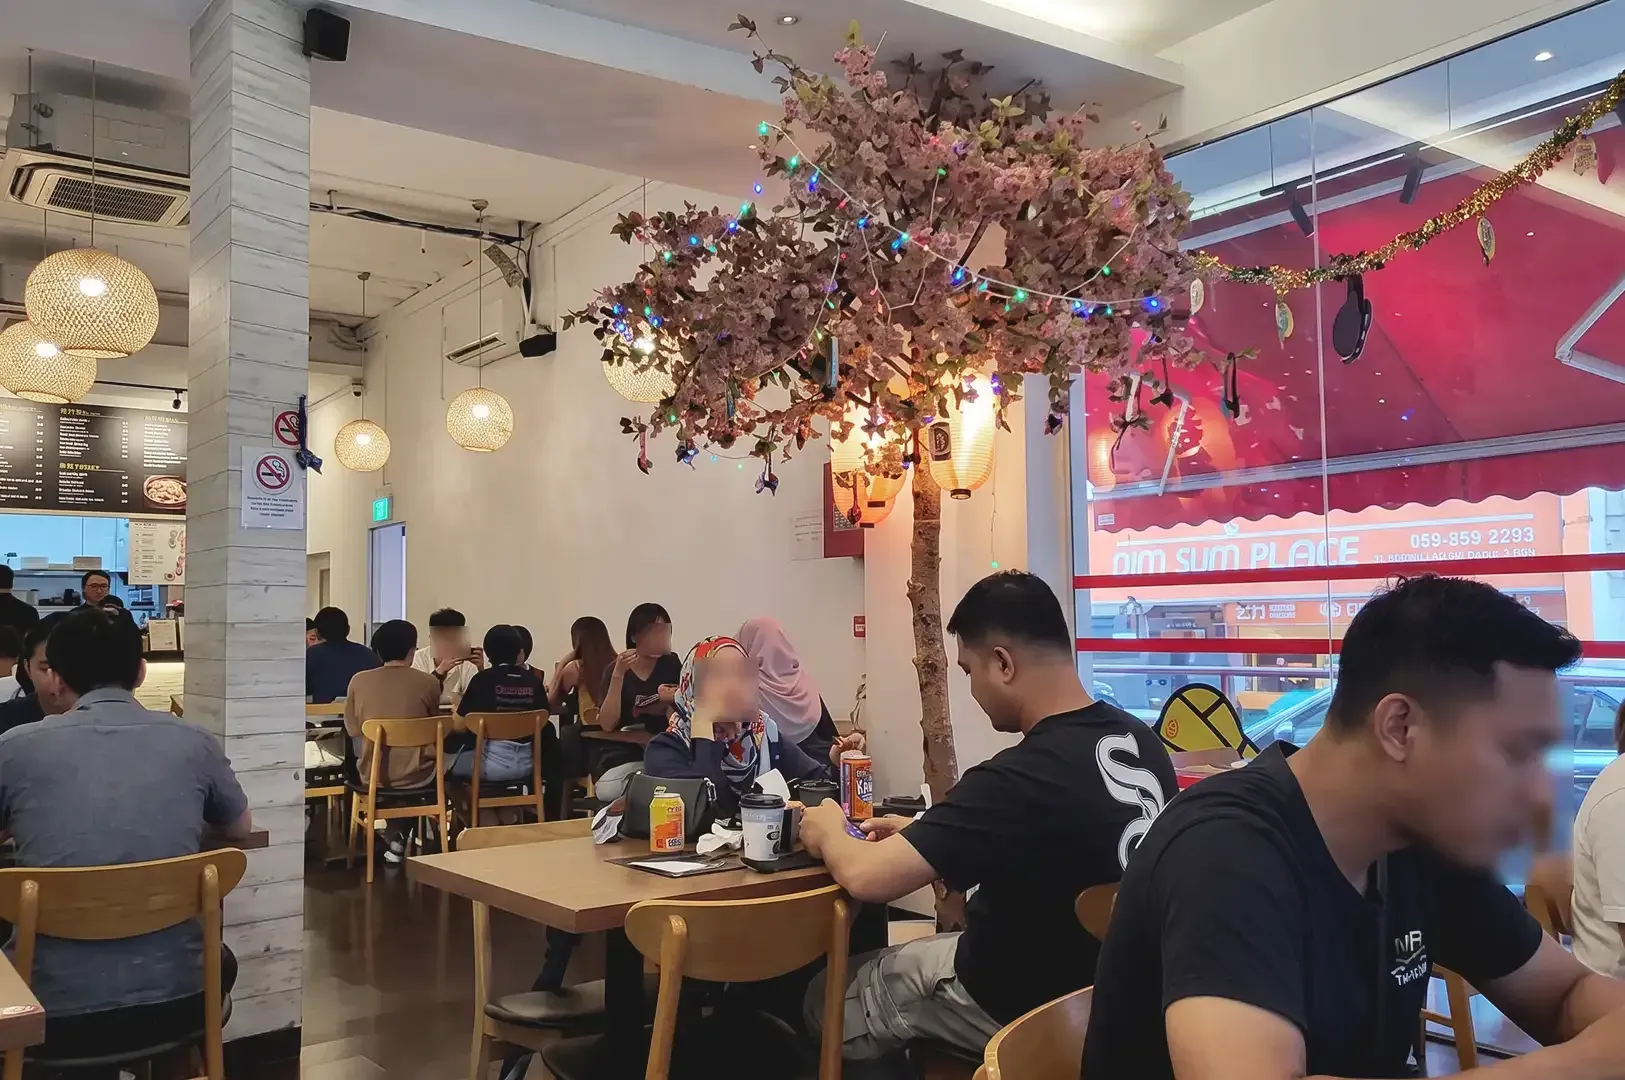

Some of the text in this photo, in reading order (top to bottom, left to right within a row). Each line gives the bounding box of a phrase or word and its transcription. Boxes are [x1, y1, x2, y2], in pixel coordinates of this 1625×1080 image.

[1410, 526, 1535, 548] 059-859 2293
[1175, 543, 1240, 573] SUM
[1250, 536, 1361, 569] PLACE
